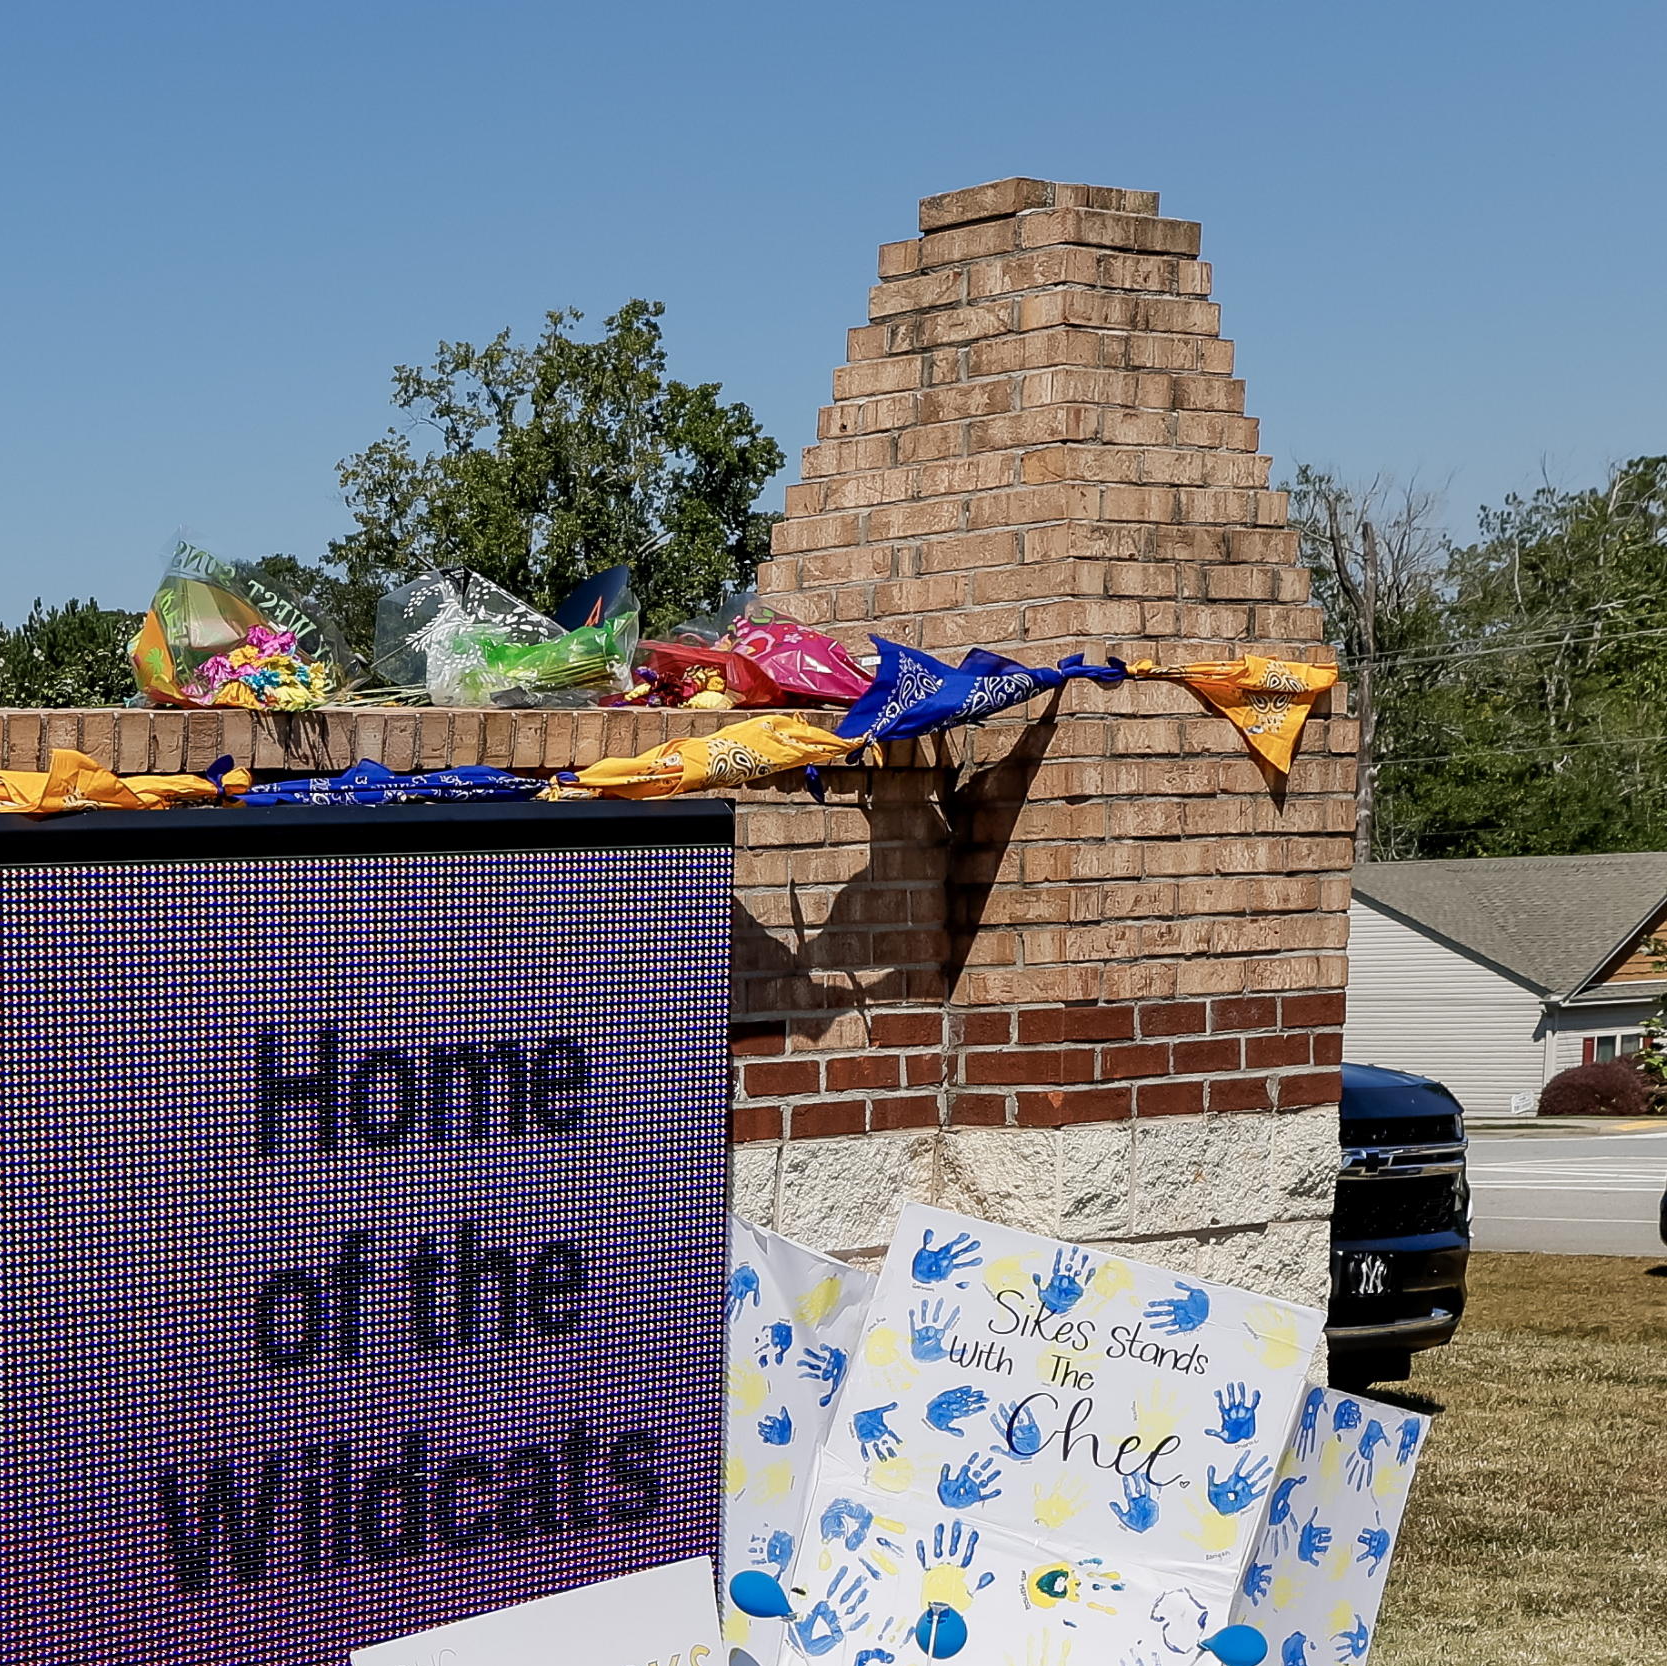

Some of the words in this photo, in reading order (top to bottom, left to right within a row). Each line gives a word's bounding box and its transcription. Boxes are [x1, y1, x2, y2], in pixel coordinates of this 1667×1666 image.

[263, 1030, 588, 1155] Home
[258, 1232, 365, 1368] of
[406, 1221, 588, 1352] the
[988, 1289, 1096, 1351] Sikes
[164, 1421, 660, 1591] Wildcats
